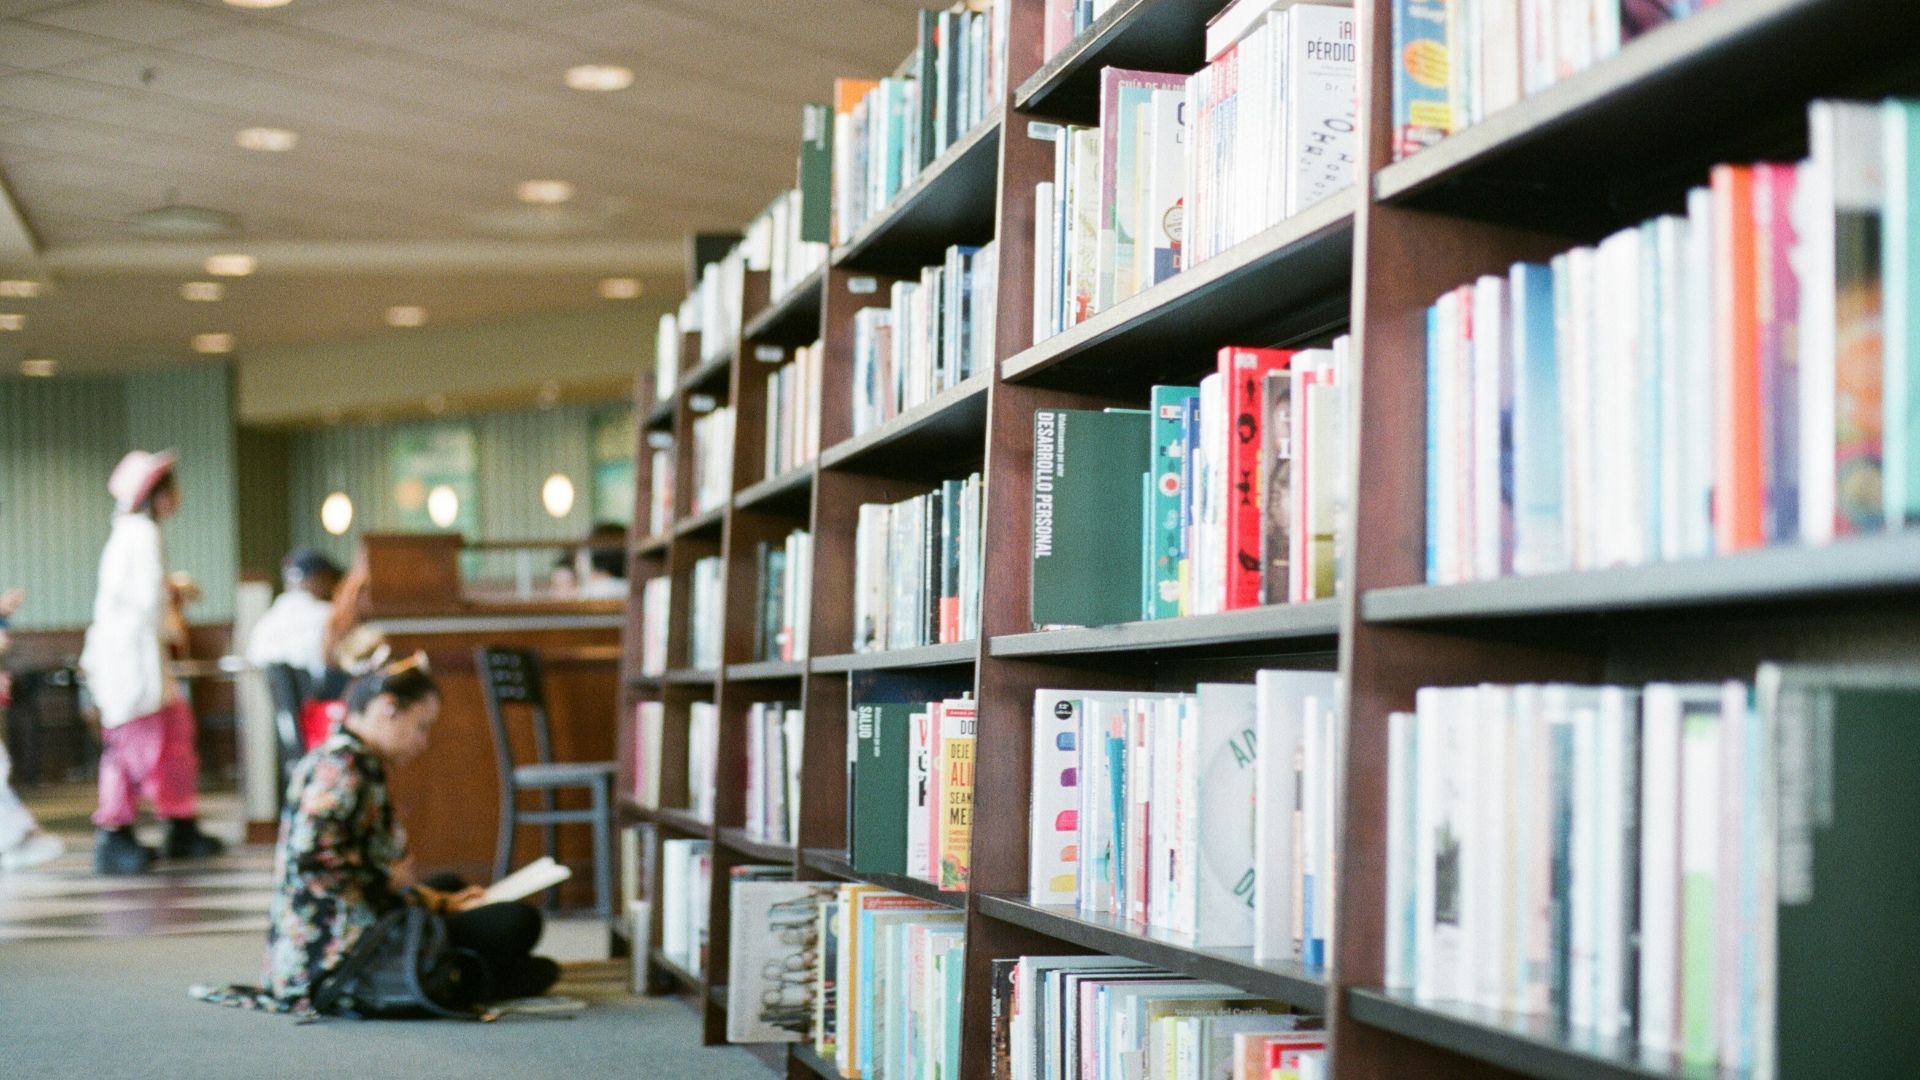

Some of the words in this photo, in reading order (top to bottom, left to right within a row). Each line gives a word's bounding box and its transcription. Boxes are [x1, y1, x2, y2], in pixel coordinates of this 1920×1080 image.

[1036, 411, 1055, 492] DESARROLLO
[1035, 494, 1053, 559] PERSONAL
[858, 705, 873, 739] SALUD
[950, 743, 970, 759] DEJE
